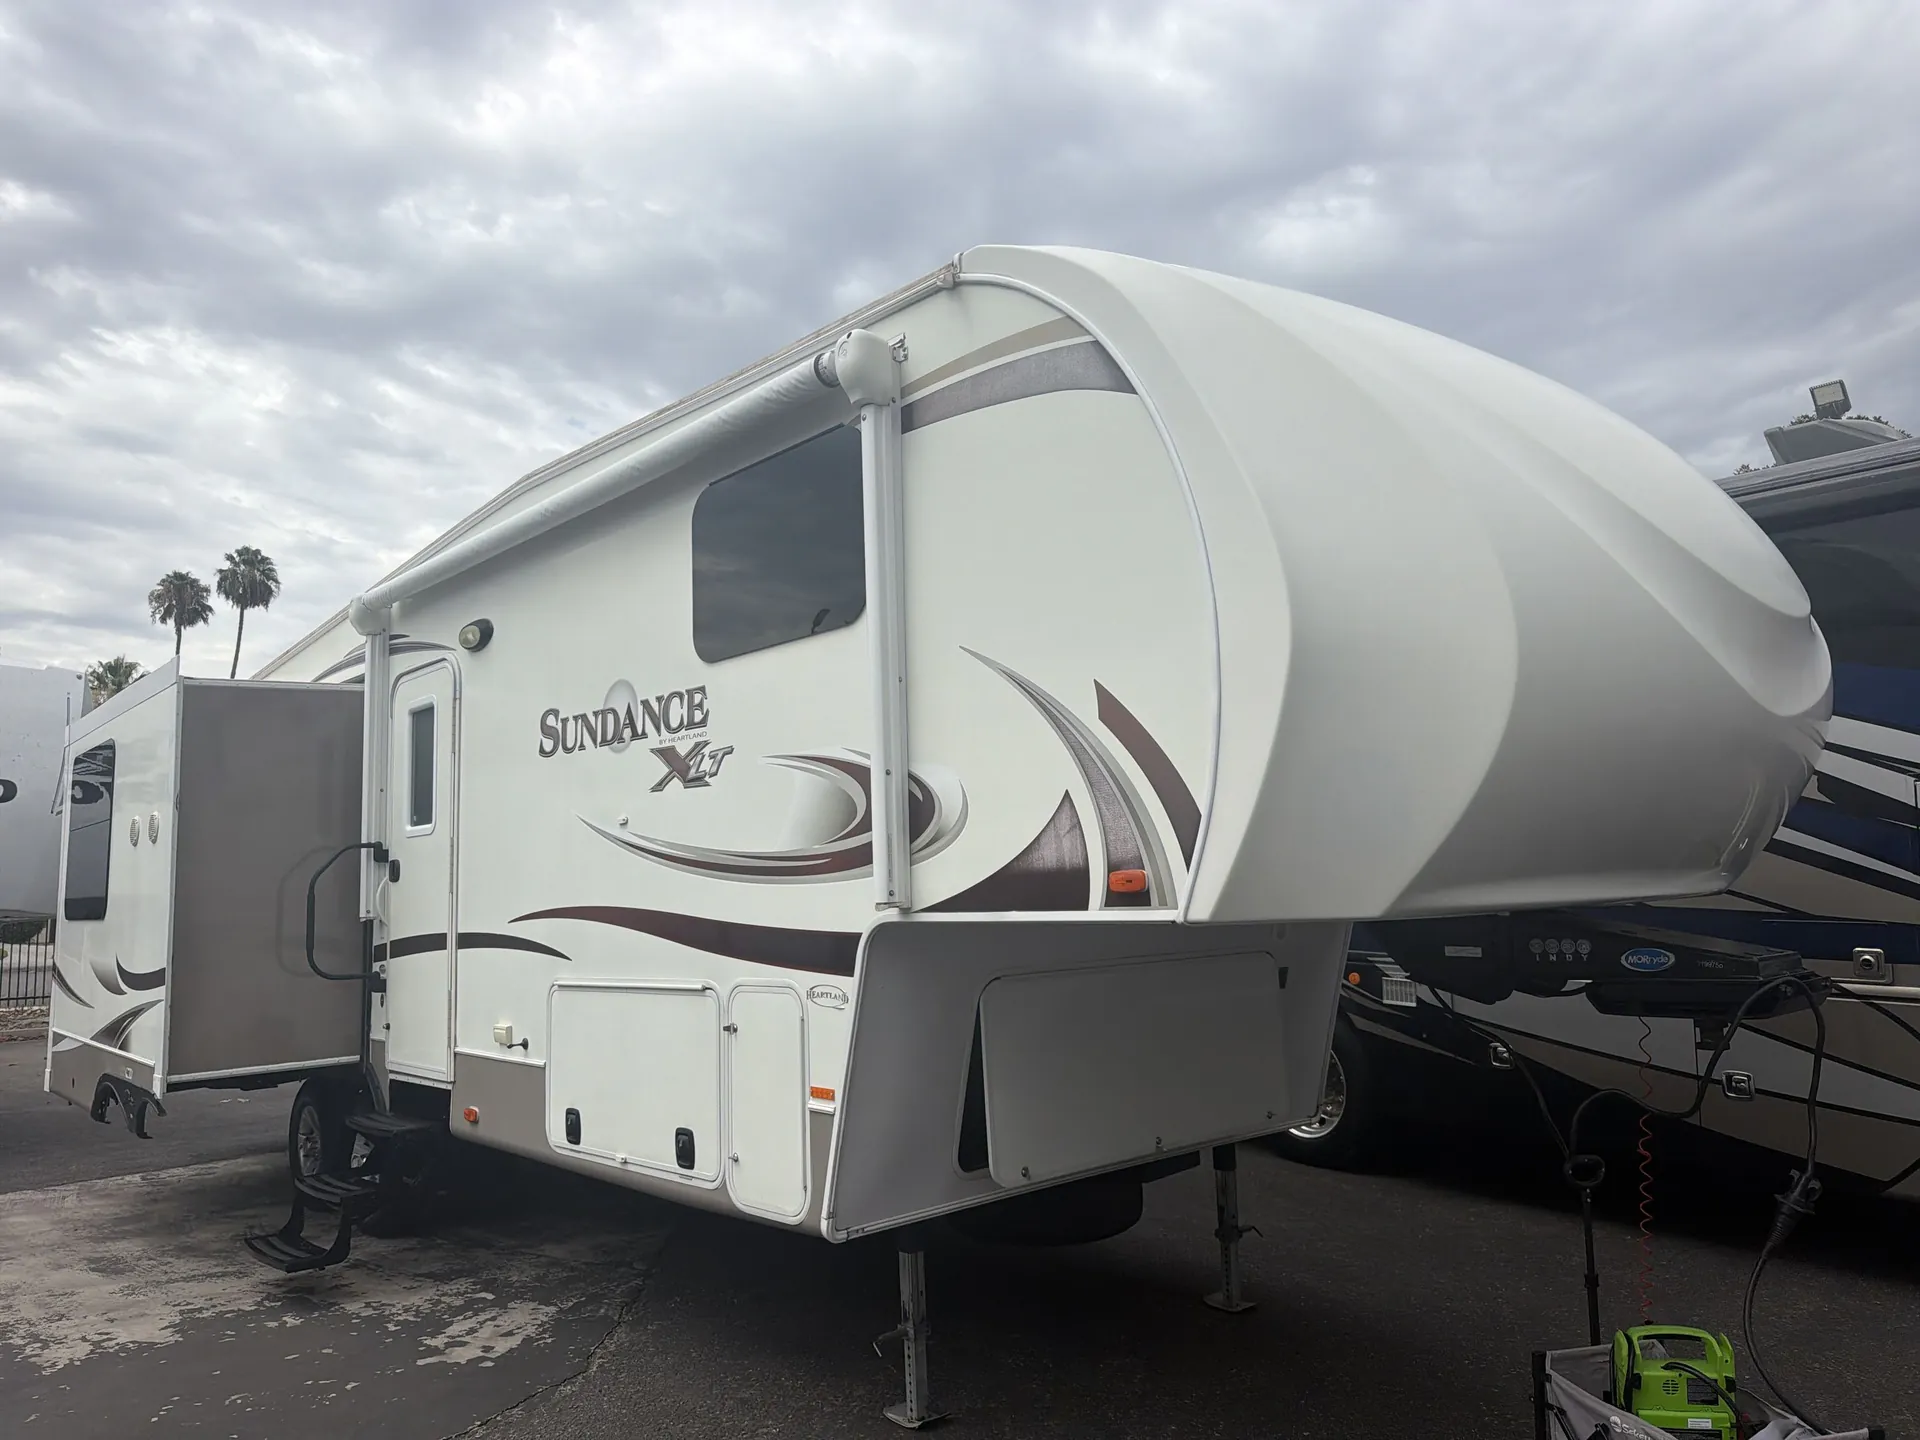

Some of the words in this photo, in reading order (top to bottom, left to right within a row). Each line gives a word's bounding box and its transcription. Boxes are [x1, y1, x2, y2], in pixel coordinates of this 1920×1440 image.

[538, 684, 710, 758] SUNDANCE
[658, 737, 668, 745] BY
[668, 731, 708, 744] HEARTLAND
[648, 739, 735, 793] XLT
[1627, 954, 1669, 965] MORryde
[806, 989, 850, 1004] HEARTLAND
